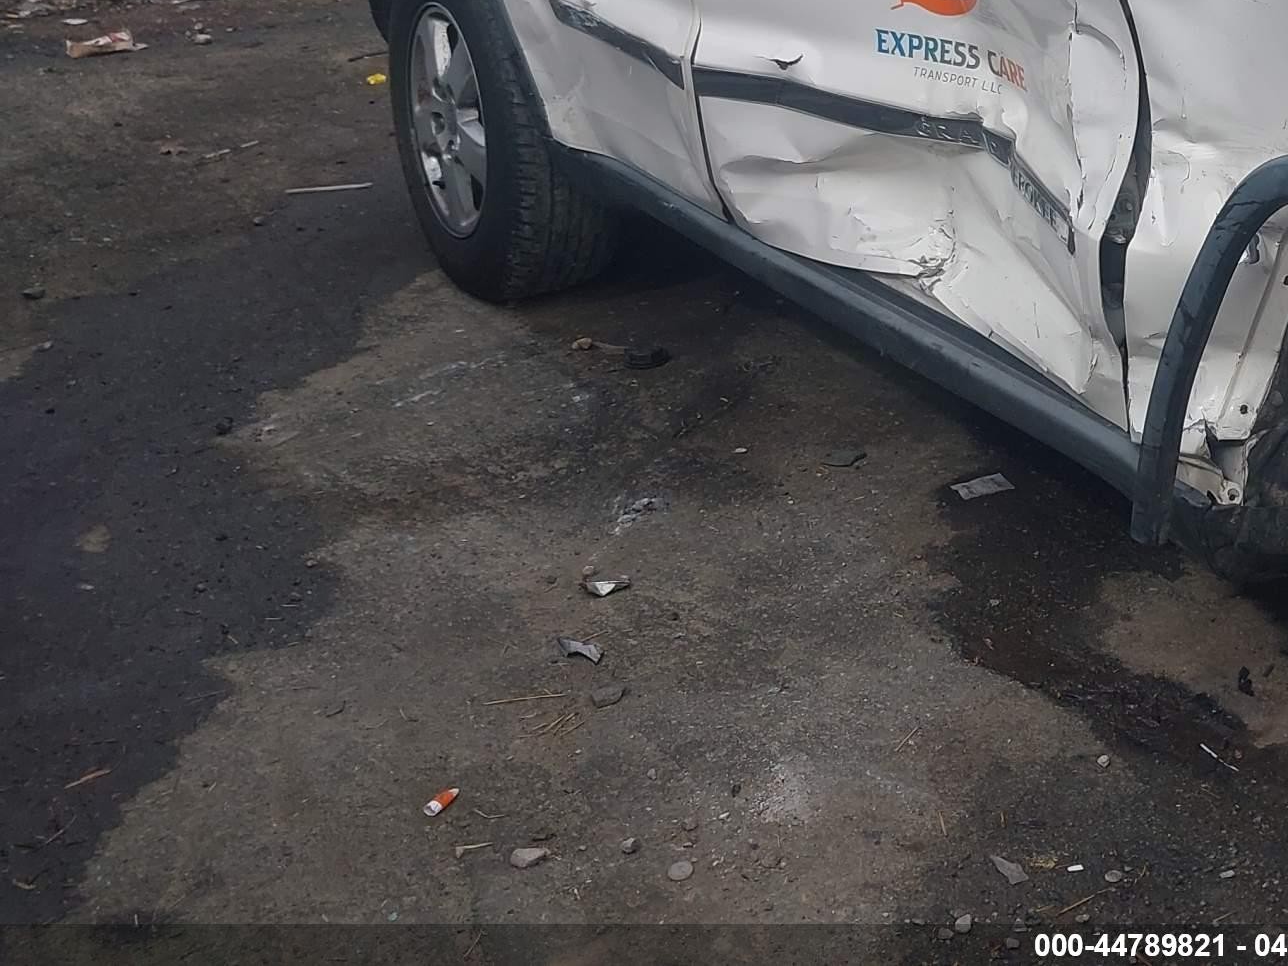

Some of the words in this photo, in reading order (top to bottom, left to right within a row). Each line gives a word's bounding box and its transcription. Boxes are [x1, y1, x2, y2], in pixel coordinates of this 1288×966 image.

[875, 28, 981, 70] EXPRESS
[987, 49, 1028, 92] CARE
[913, 66, 978, 89] TRANSPORT
